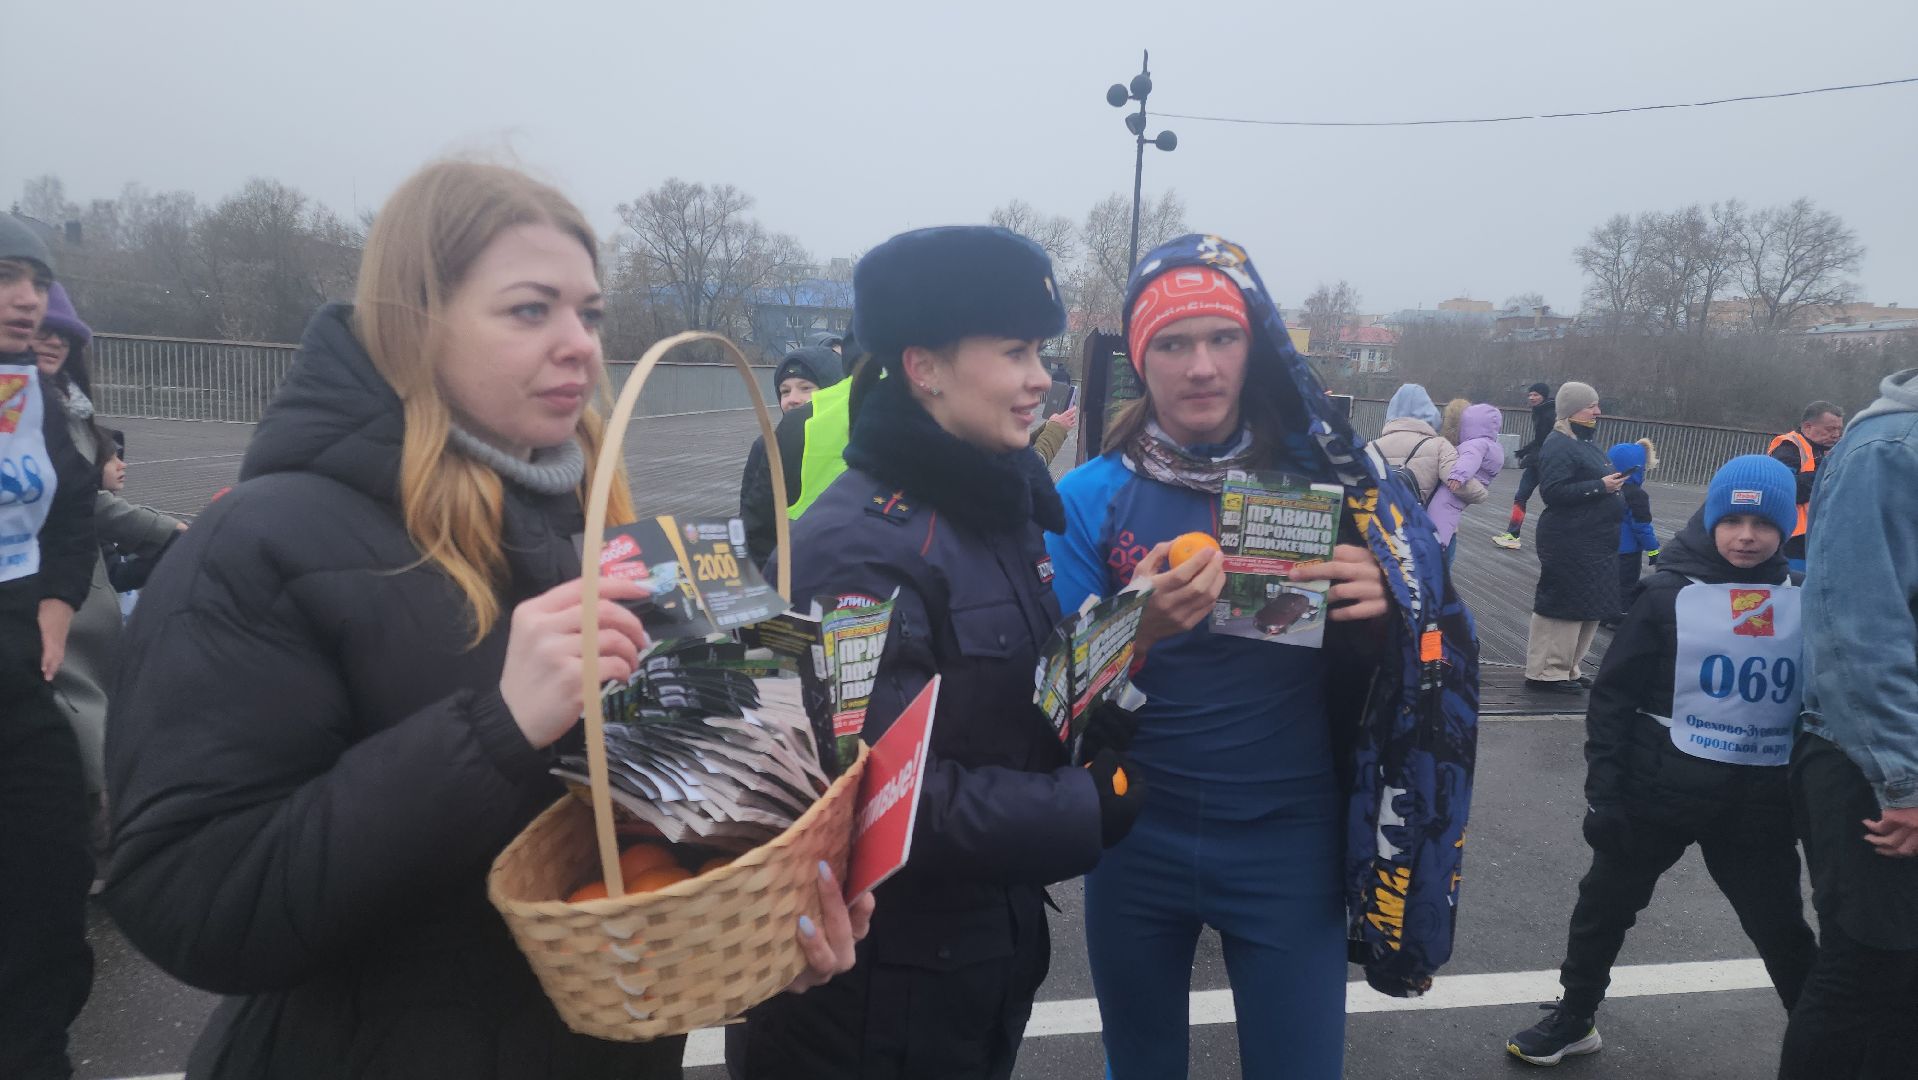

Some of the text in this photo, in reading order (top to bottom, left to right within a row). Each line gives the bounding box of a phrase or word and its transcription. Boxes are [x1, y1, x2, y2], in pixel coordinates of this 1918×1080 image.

[1246, 505, 1332, 530] ПРАВИЛА
[1245, 522, 1332, 544] ДОРОЖНОГО
[1243, 535, 1330, 556] ДВИЖЕНИЯ
[693, 553, 739, 581] 2000
[1699, 654, 1796, 704] 069
[1690, 733, 1758, 753] городской
